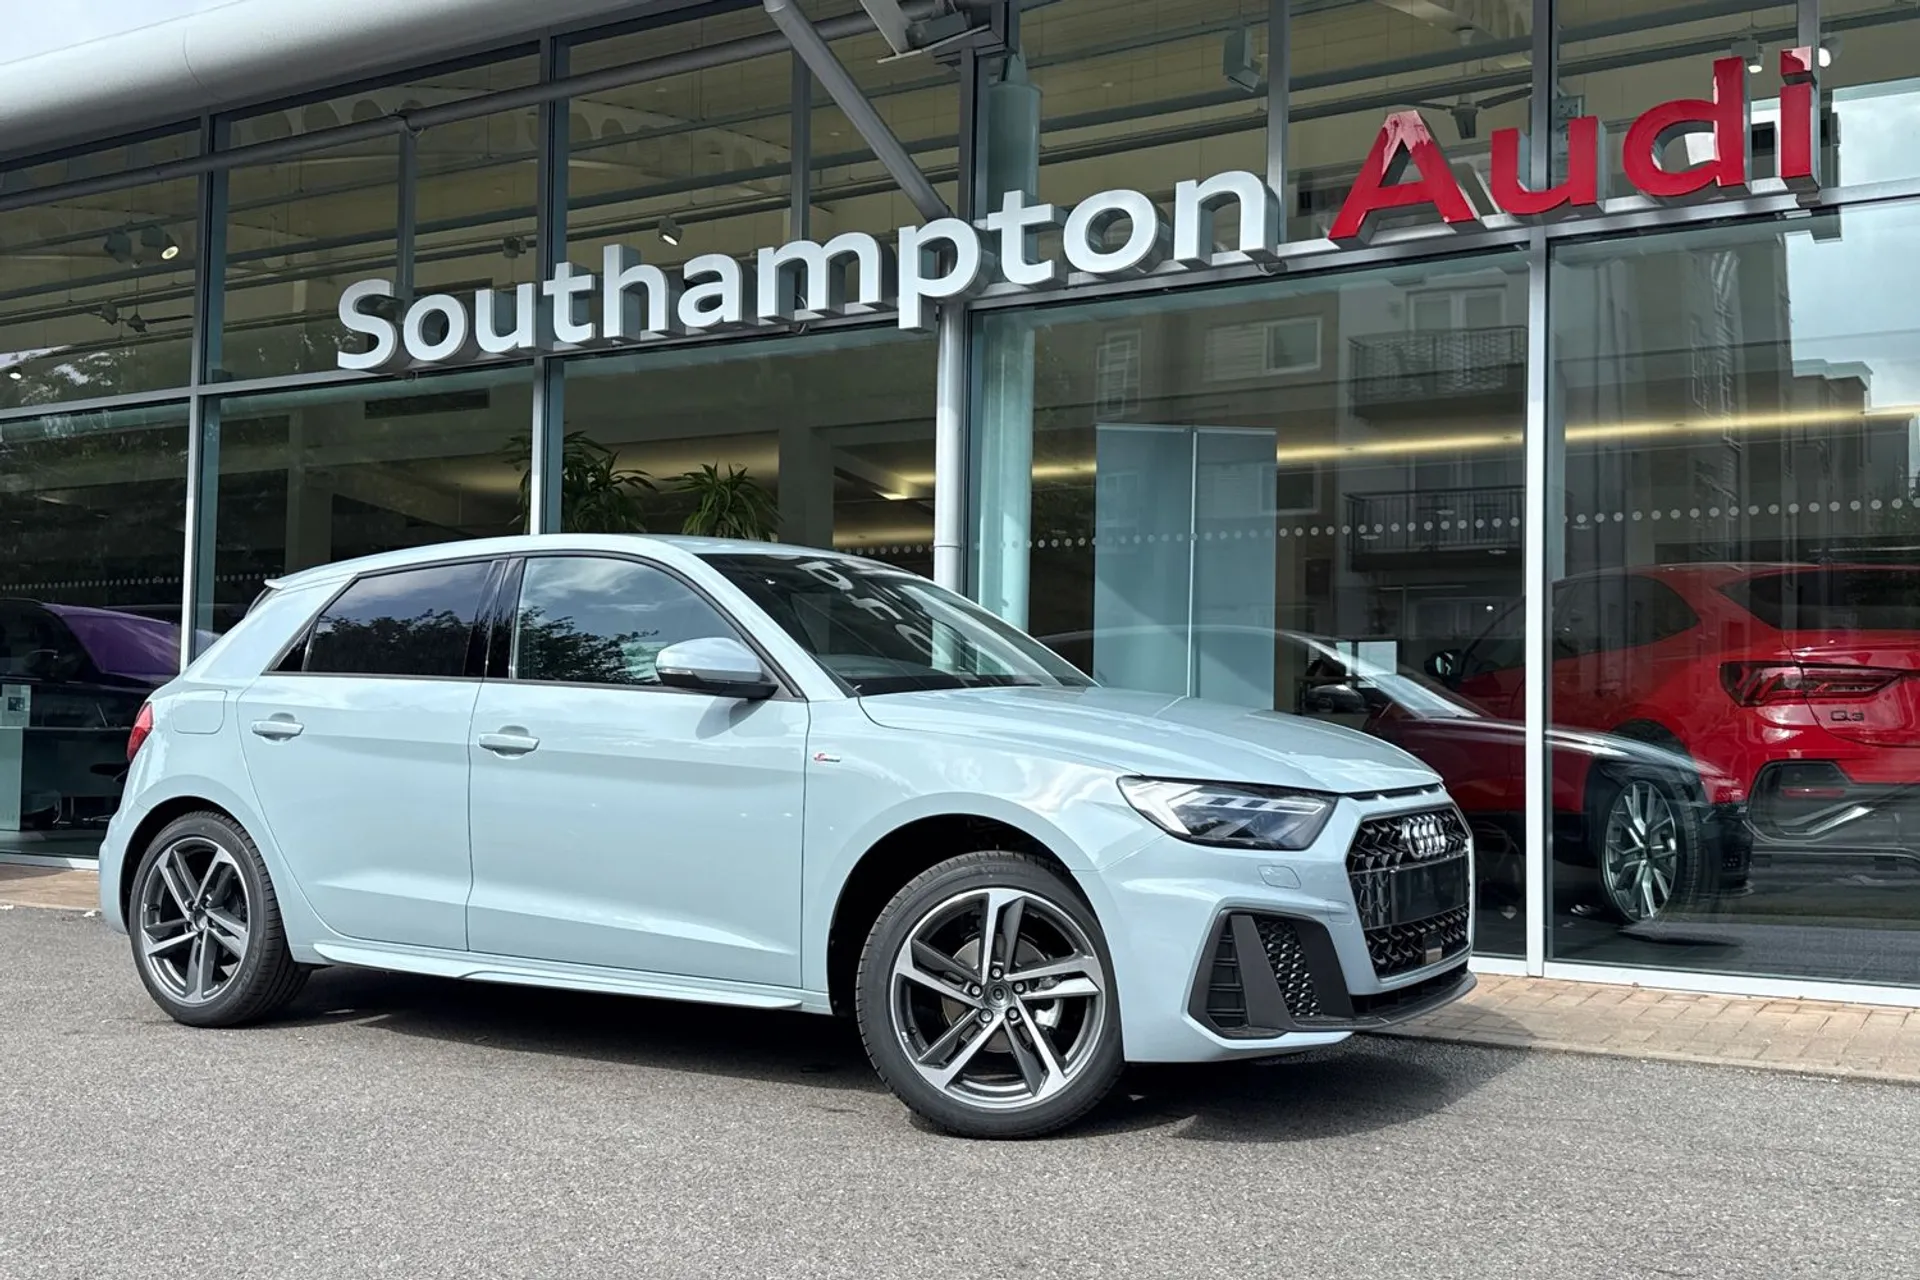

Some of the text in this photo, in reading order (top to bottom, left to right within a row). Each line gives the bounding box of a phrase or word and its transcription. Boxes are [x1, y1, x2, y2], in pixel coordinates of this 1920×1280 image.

[337, 46, 1815, 370] Southampton Audi
[1830, 710, 1865, 721] Q3
